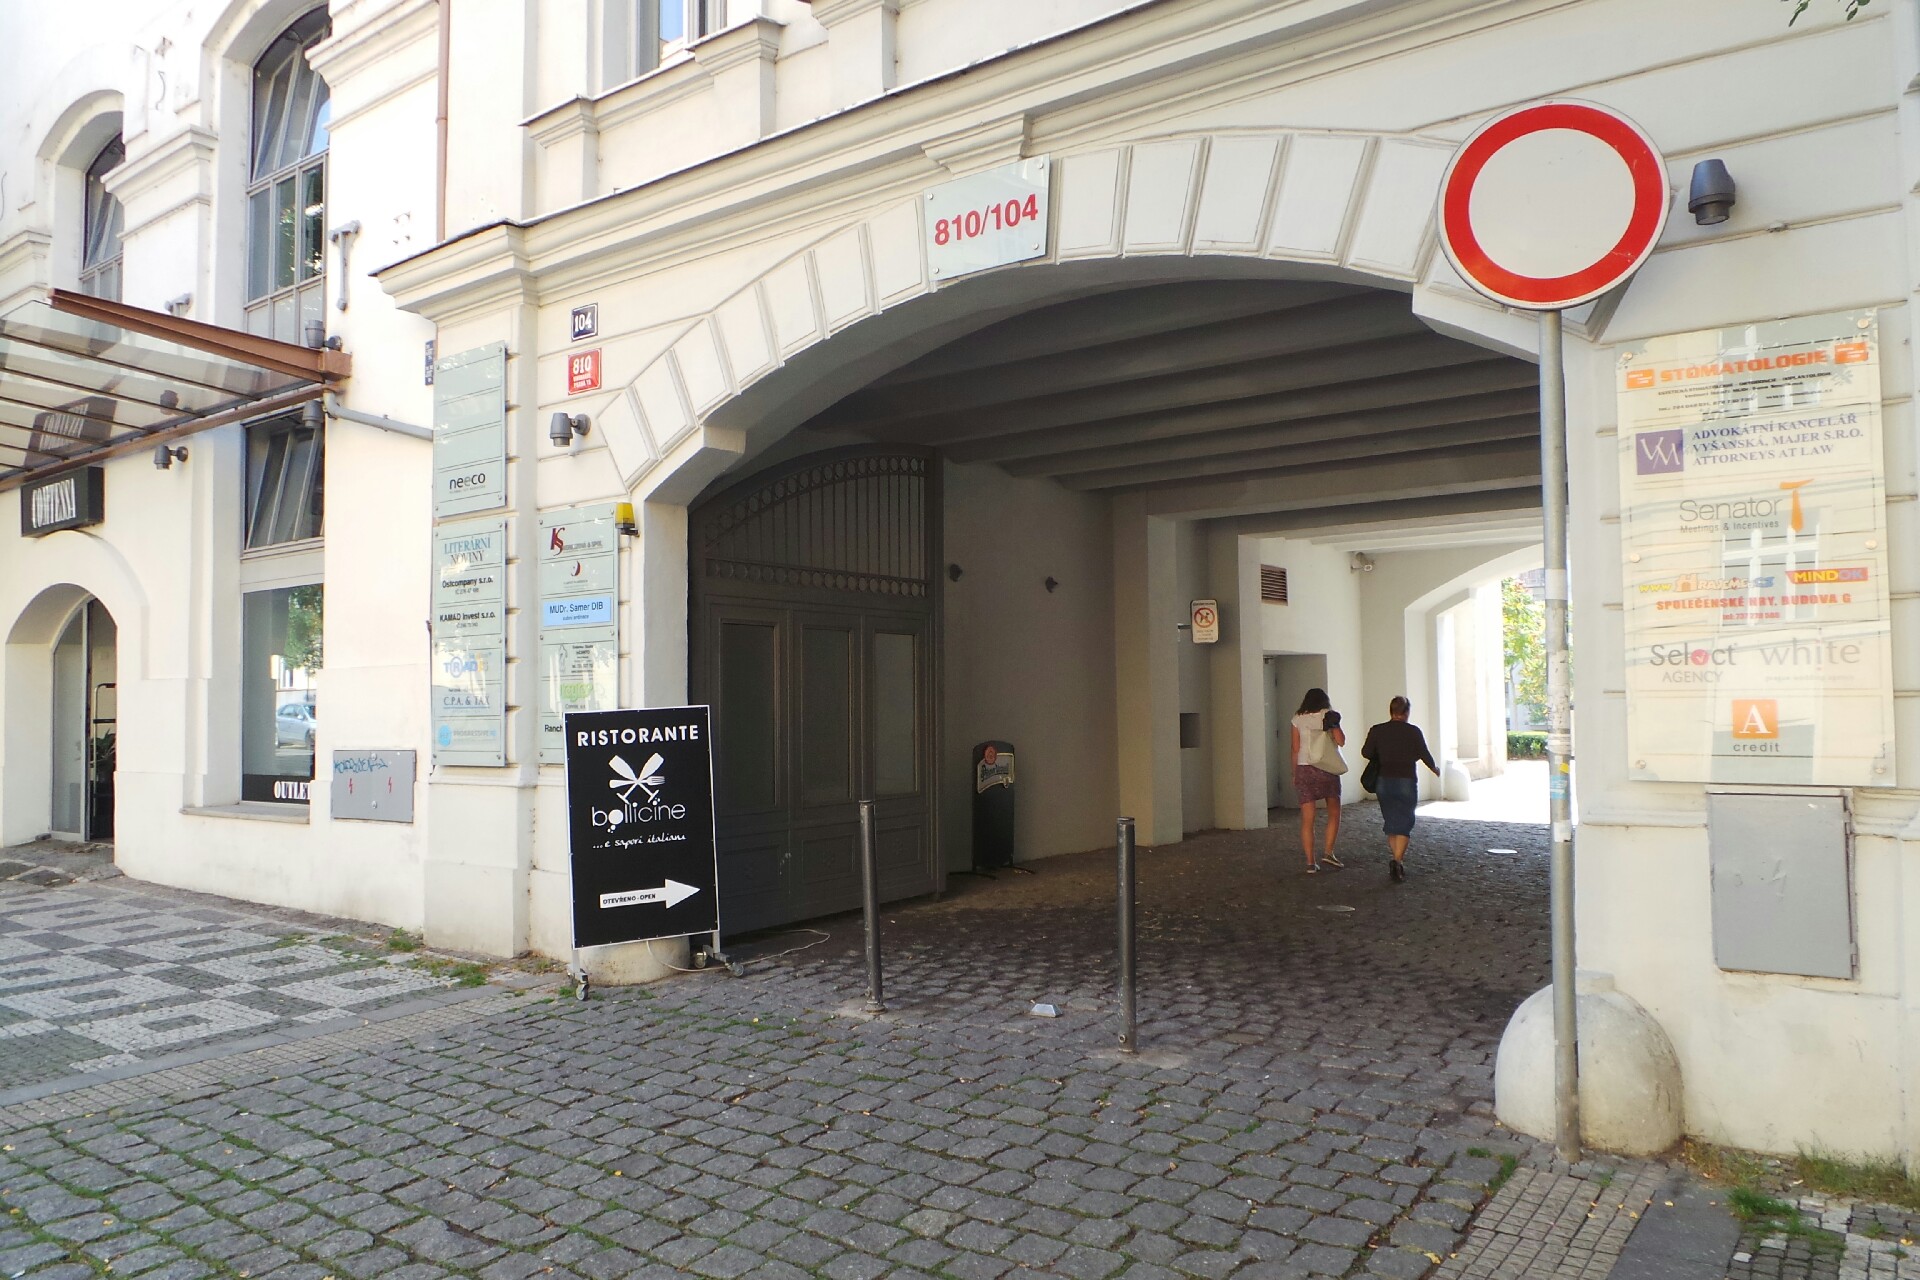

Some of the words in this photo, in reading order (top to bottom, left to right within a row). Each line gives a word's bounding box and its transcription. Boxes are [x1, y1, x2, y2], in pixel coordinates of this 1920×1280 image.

[934, 193, 1039, 246] 810/104
[574, 312, 592, 332] 104
[573, 355, 592, 375] 810
[1660, 349, 1828, 382] STOMATOLOGIE
[1692, 420, 1774, 440] ADVOKÁTNÍ
[1777, 413, 1857, 431] KANCELÁŘ
[1772, 432, 1819, 447] MAJER
[1823, 428, 1864, 442] S.R.O.
[1692, 450, 1775, 466] ATTORNEYS
[1778, 447, 1797, 459] AT
[1801, 444, 1835, 457] LAW
[449, 472, 486, 490] neeco
[1679, 498, 1783, 522] Senator
[1680, 524, 1719, 534] Meetings
[1723, 523, 1729, 531] &
[1733, 520, 1780, 530] Incentives
[444, 534, 491, 555] LITERÁRNÍ
[450, 550, 485, 566] NOVINY
[442, 577, 478, 589] Ostcompany
[479, 575, 494, 585] s.r.o.
[1793, 569, 1864, 583] MINDOK
[549, 604, 569, 614] MUDr.
[569, 603, 591, 612] Samer
[591, 601, 604, 611] DIB
[1656, 595, 1745, 611] SPOLEČENSKÉ
[1781, 594, 1838, 605] BUDOVA
[1842, 593, 1852, 603] G
[439, 612, 461, 623] KAMAD
[462, 611, 480, 621] Invest
[480, 610, 496, 619] s.r.o.
[1760, 638, 1861, 668] white
[1661, 670, 1724, 684] AGENCY
[443, 696, 464, 706] C.P.A.
[465, 696, 471, 706] &
[474, 695, 490, 706] TAX
[1738, 704, 1773, 734] A
[577, 724, 699, 747] RISTORANTE
[1733, 741, 1780, 753] credit
[591, 799, 686, 828] bollicine
[614, 835, 644, 850] sapori
[603, 895, 637, 905] OTEVŘENO
[640, 893, 656, 901] OPEN
